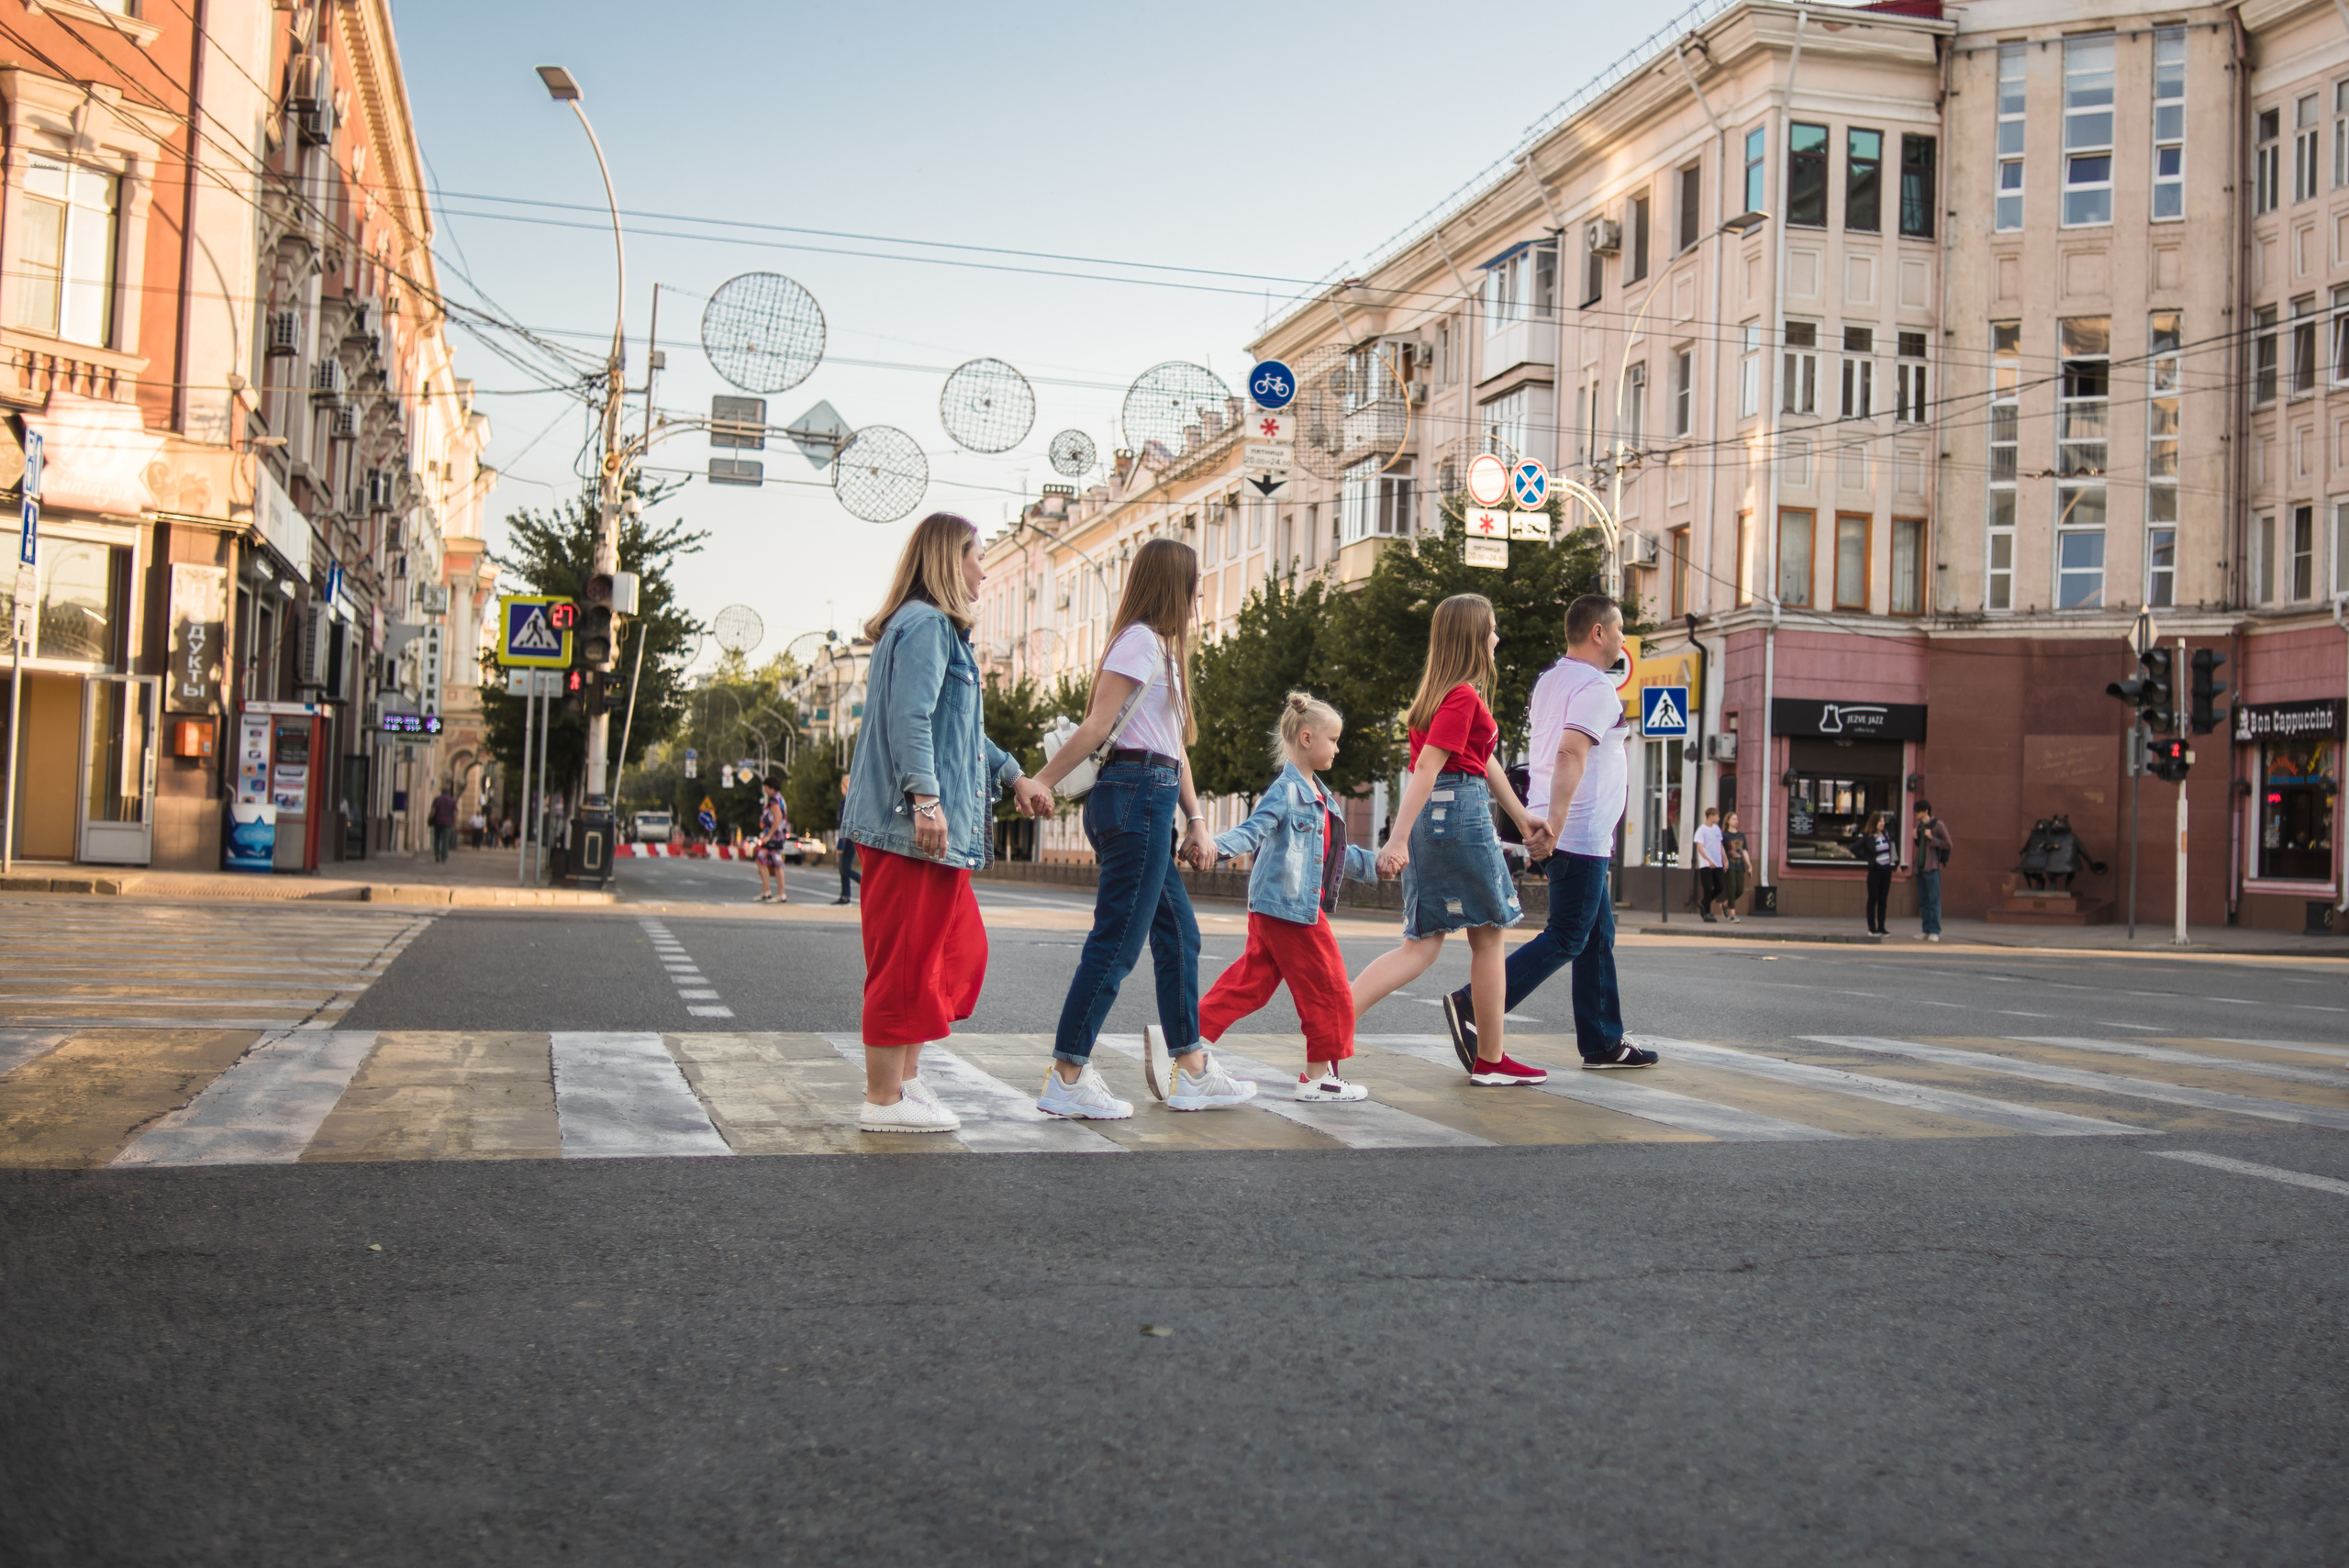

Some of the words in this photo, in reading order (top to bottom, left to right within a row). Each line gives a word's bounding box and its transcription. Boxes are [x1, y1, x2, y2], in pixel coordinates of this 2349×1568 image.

[552, 605, 573, 627] 27
[425, 628, 438, 715] АПТЕКА
[1846, 715, 1866, 725] JEZVE
[1868, 716, 1884, 725] JAZZ
[2251, 712, 2271, 733] Bon
[2274, 706, 2332, 735] Cappuccino
